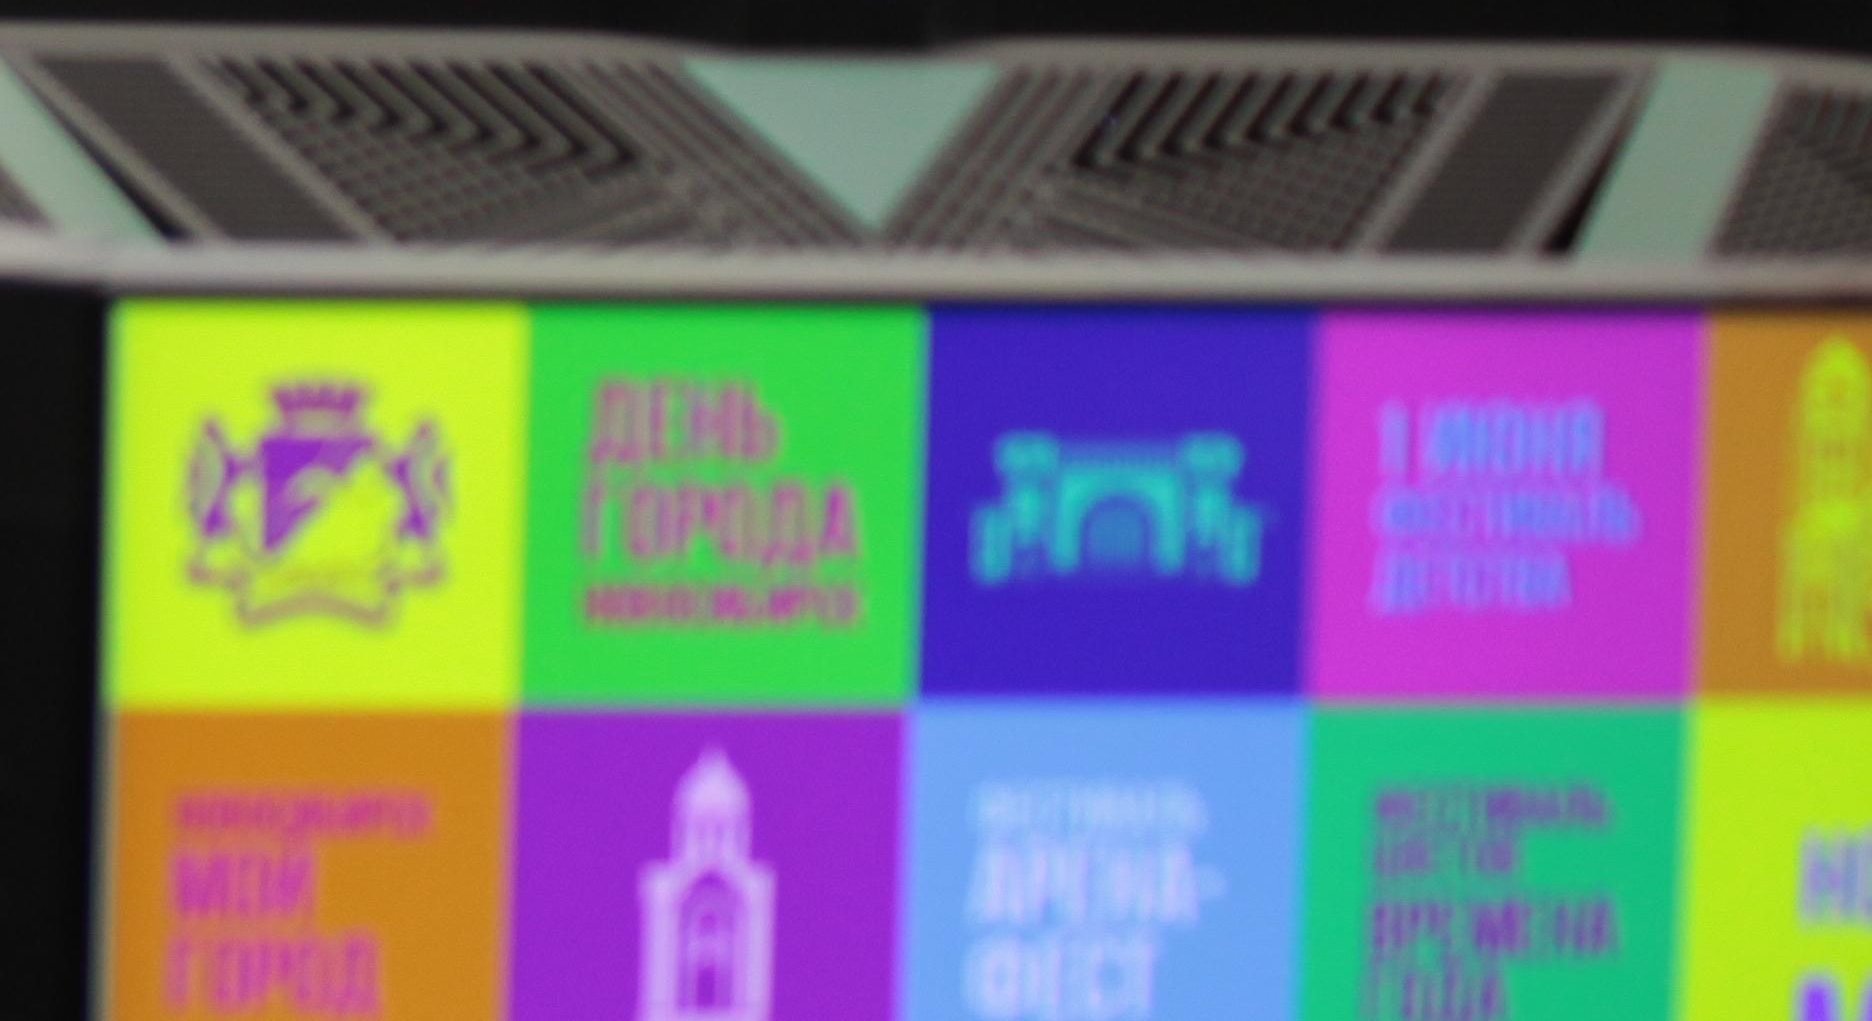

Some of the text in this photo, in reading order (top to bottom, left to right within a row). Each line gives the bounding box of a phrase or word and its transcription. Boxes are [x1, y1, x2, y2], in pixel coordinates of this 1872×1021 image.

[588, 378, 785, 464] ДЕНЬ
[1424, 396, 1605, 478] ИЮНЯ
[581, 477, 864, 568] ГОРОДА
[170, 828, 316, 920] МОЙ
[1367, 896, 1623, 956] ВРЕМЕНА
[165, 930, 384, 1019] ГОРОД
[962, 933, 1162, 1020] ФЕСТ
